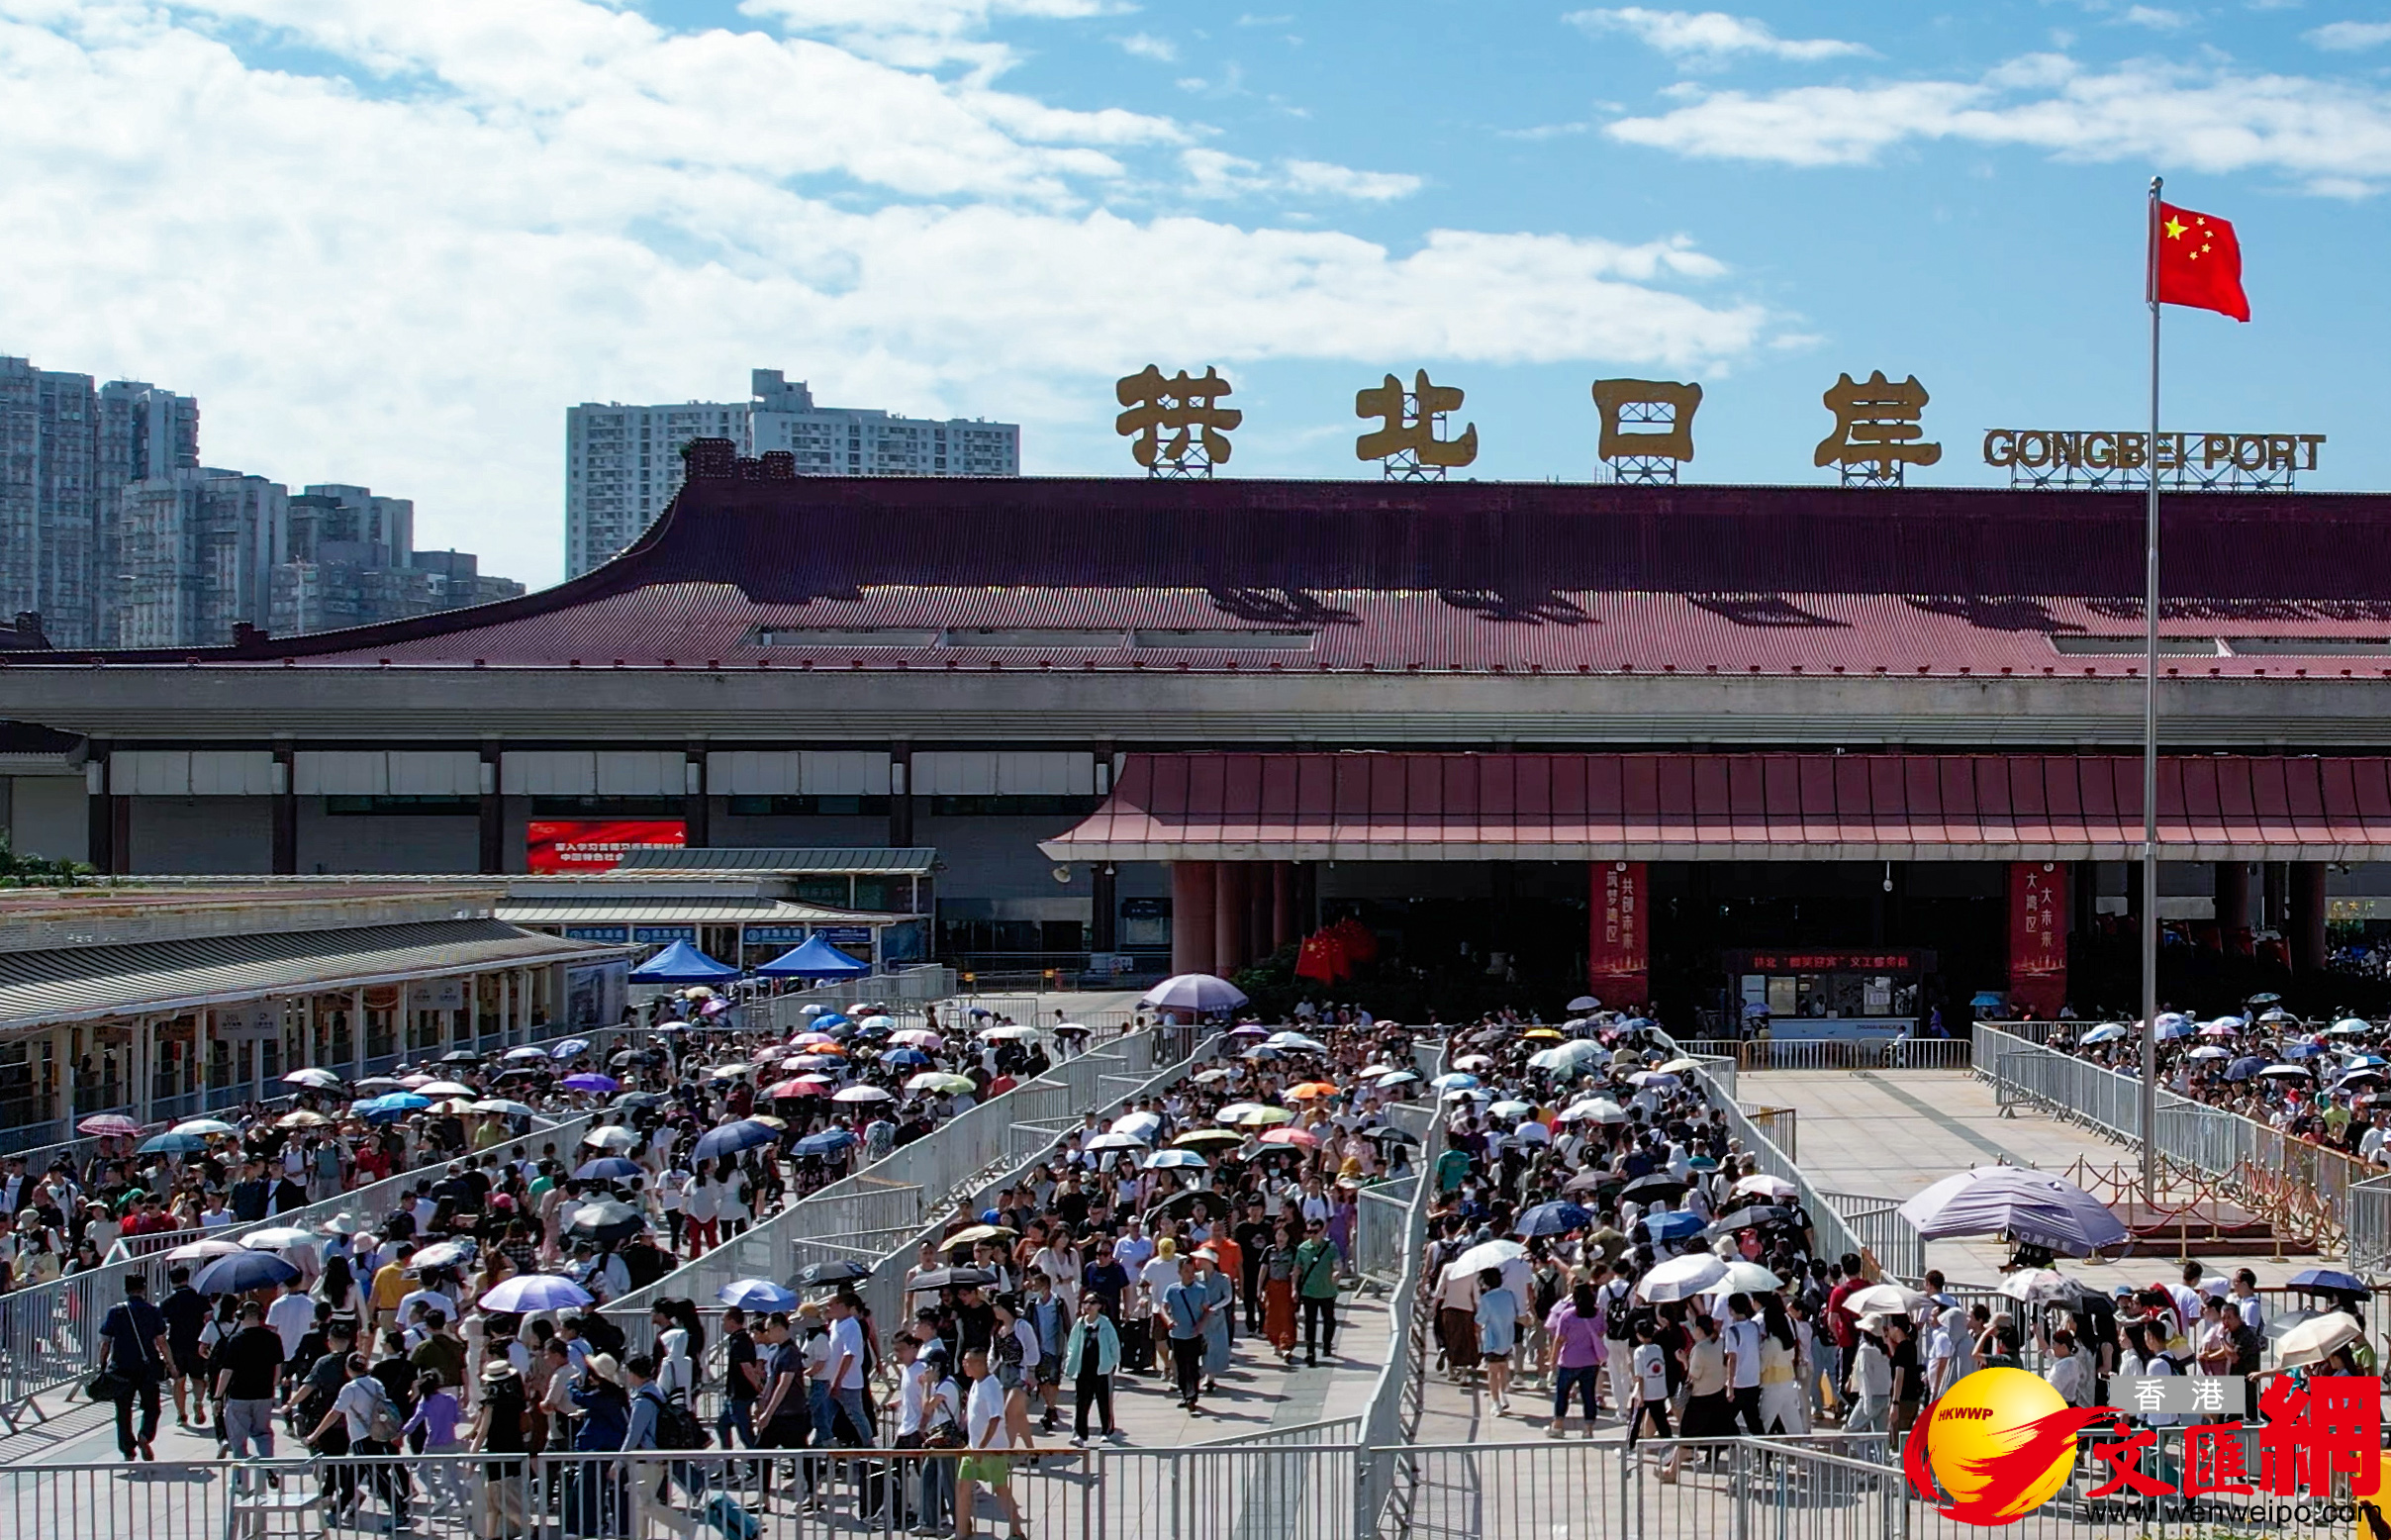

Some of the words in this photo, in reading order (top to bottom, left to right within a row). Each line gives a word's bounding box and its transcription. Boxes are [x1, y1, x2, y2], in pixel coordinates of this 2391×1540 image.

[1116, 363, 1942, 481] 拱北口岸
[1983, 429, 2184, 470] GONGBEI
[2204, 433, 2327, 471] PORT
[2026, 872, 2038, 933] 大湾区
[2041, 887, 2053, 948] 大未来
